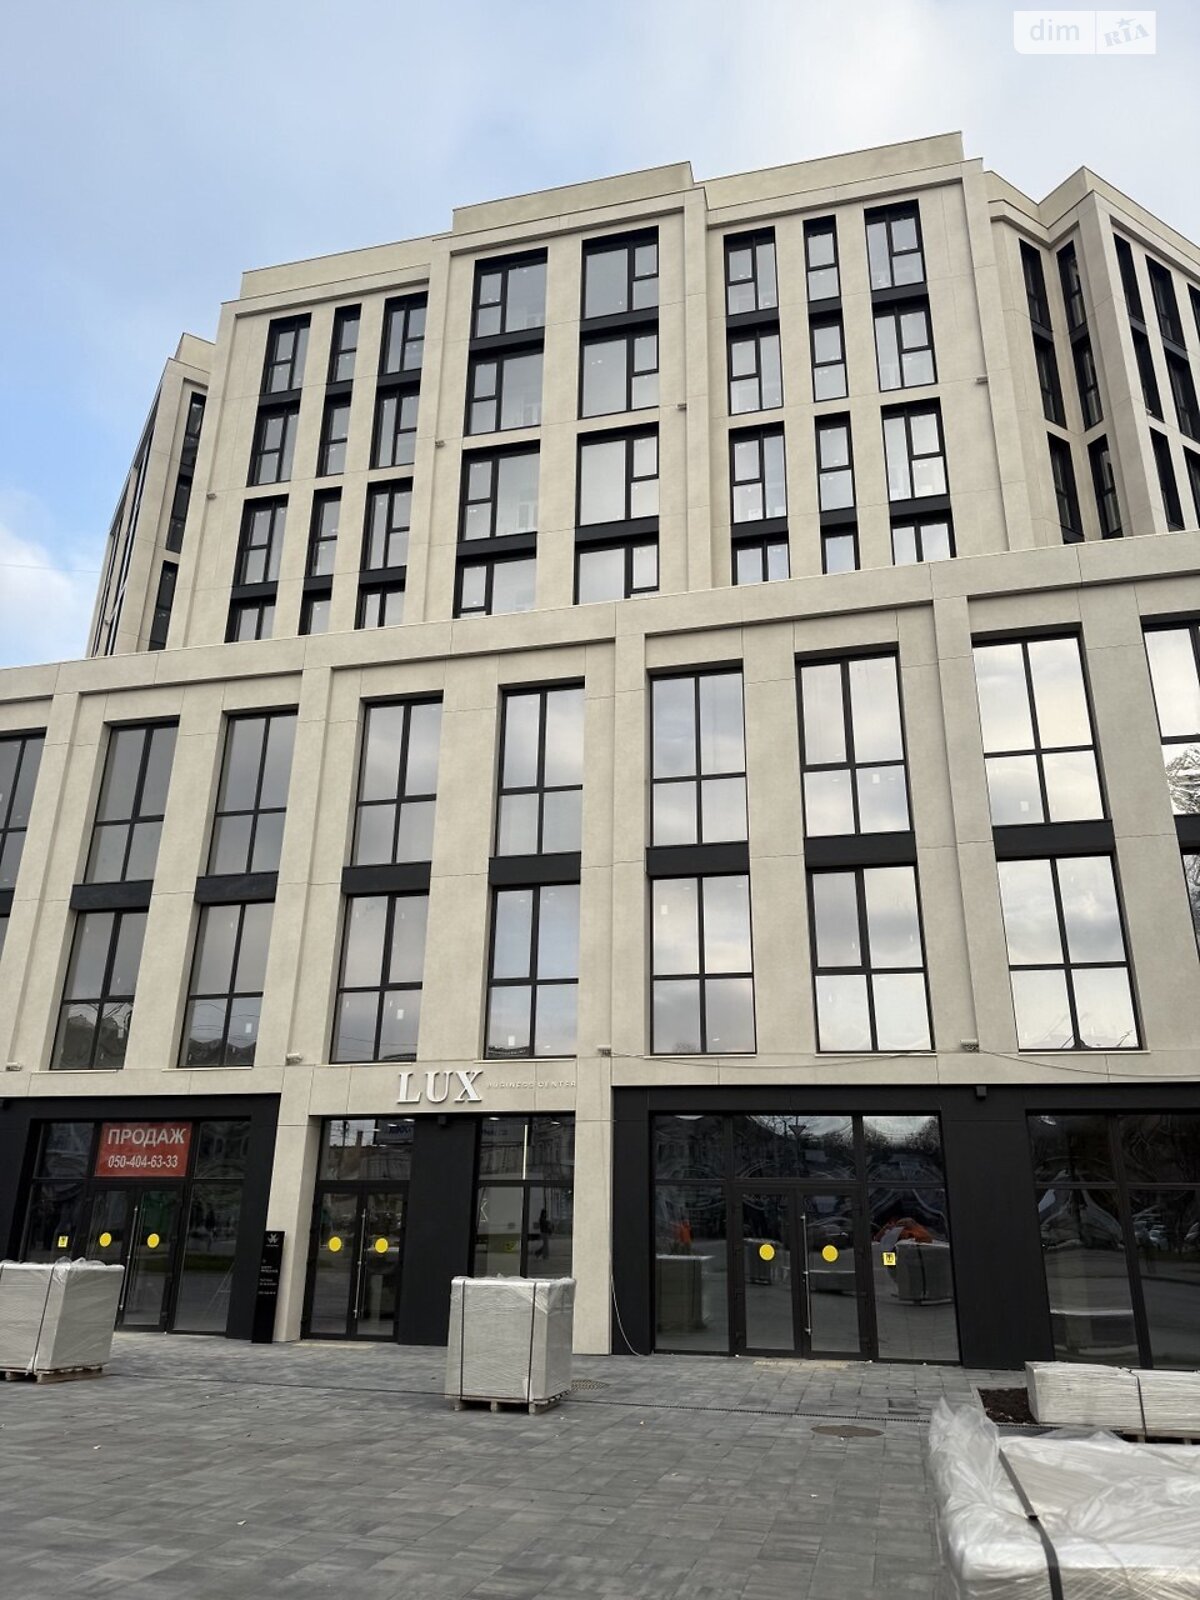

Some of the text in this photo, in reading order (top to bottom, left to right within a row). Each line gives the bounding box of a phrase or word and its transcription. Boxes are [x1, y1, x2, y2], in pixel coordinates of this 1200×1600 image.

[396, 1070, 484, 1105] LUX
[107, 1128, 187, 1148] ПРОДАЖ
[107, 1155, 178, 1169] 050-404-63-33
